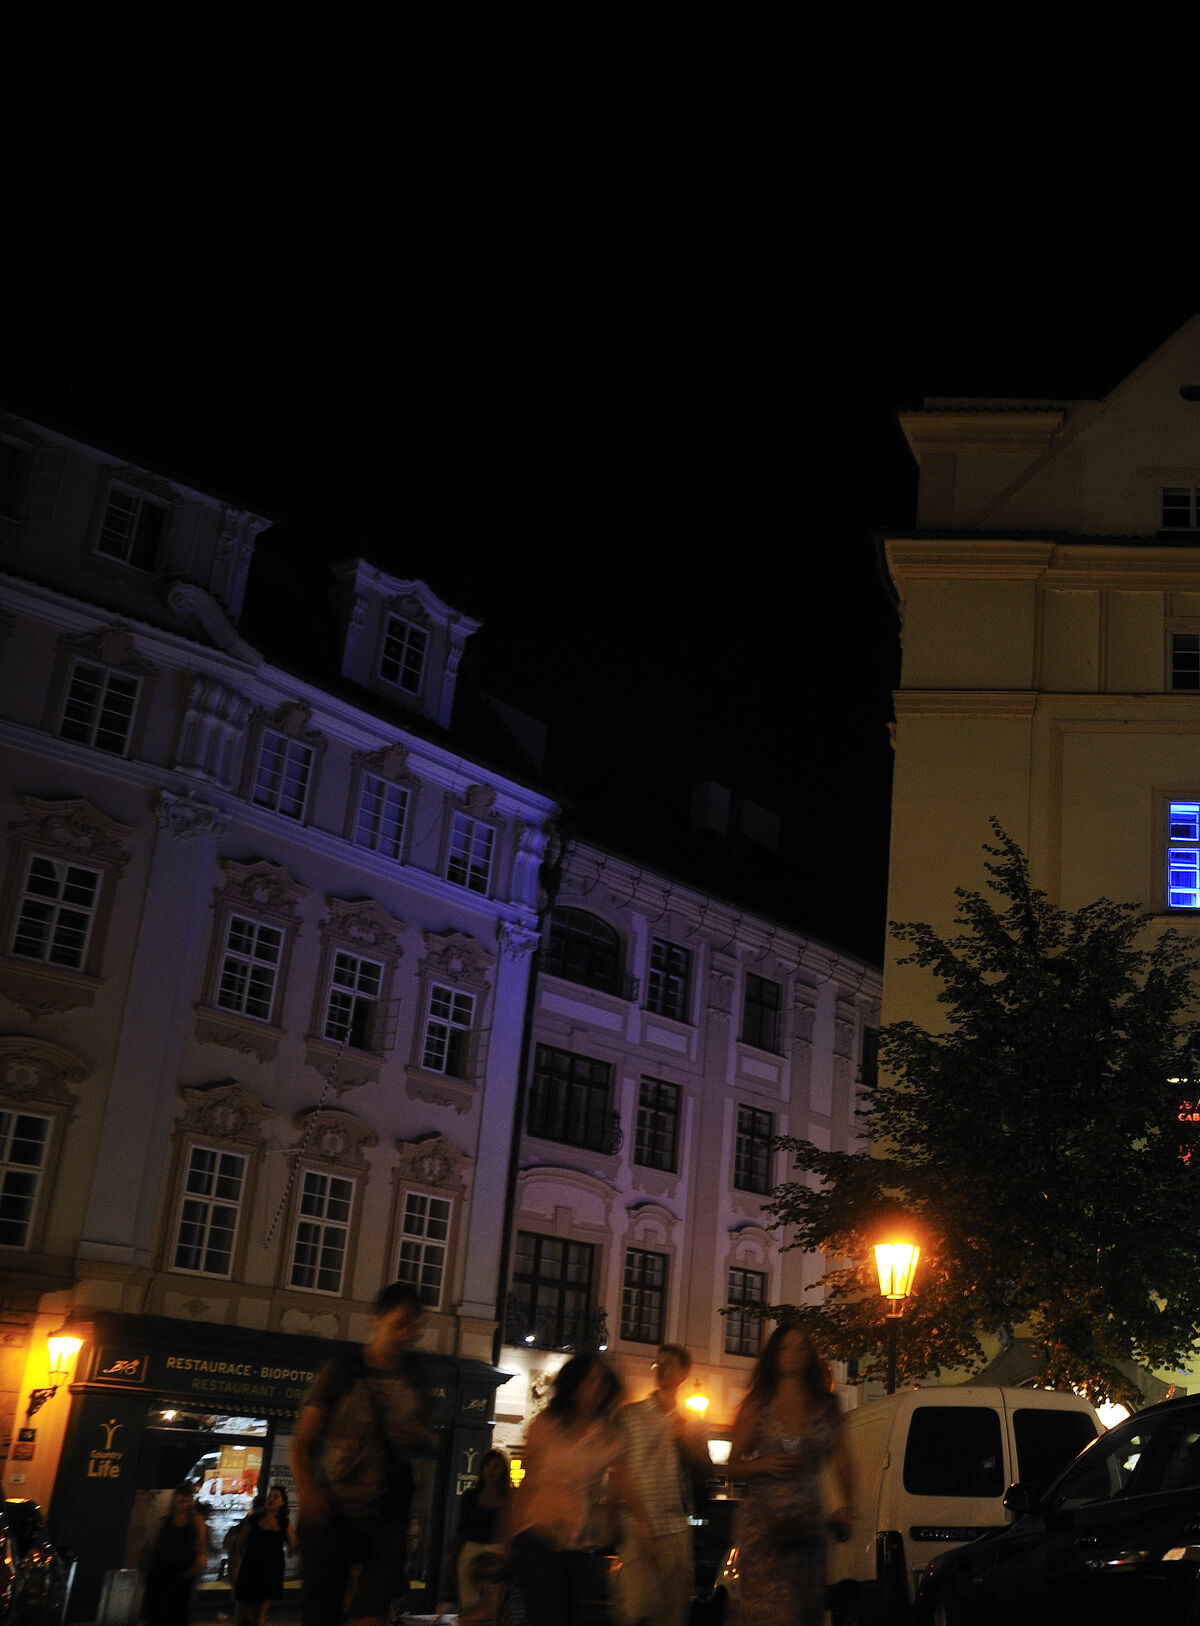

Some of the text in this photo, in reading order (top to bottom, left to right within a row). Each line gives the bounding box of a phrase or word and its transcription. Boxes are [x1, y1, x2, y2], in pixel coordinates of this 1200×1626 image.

[166, 1356, 252, 1377] RESTAURACE
[191, 1378, 276, 1398] RESTAURANT
[87, 1459, 121, 1479] Life
